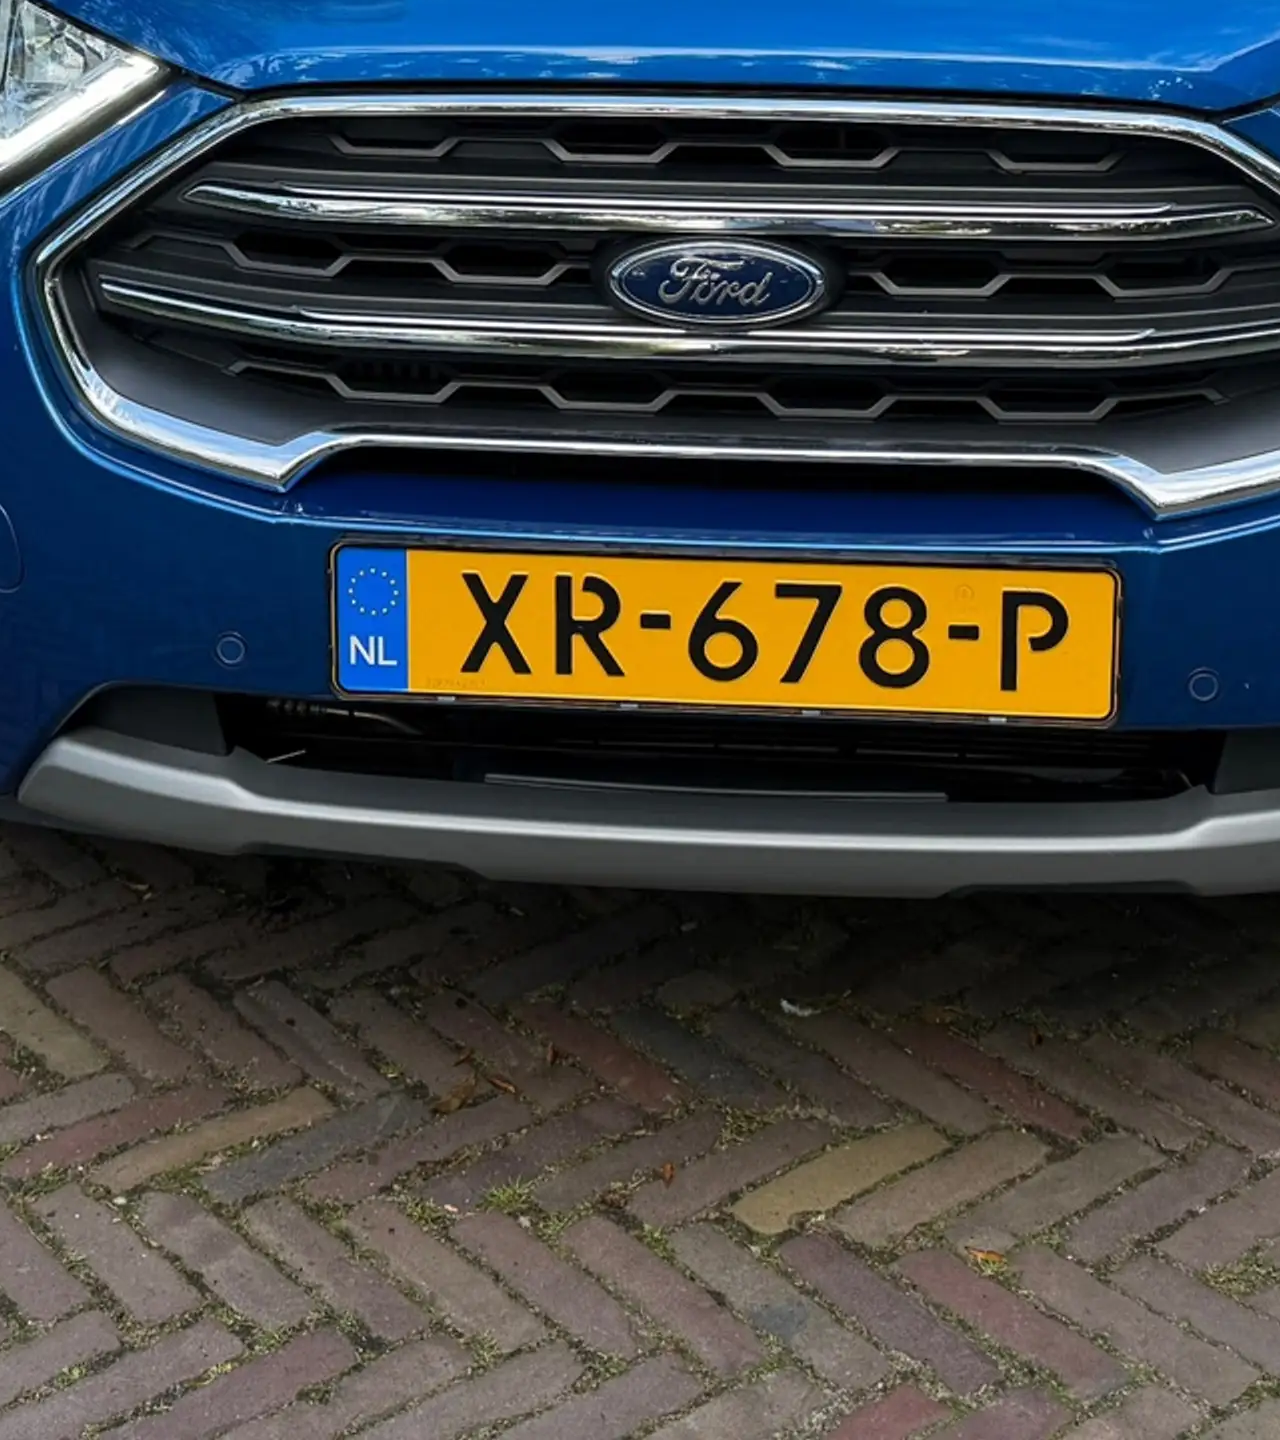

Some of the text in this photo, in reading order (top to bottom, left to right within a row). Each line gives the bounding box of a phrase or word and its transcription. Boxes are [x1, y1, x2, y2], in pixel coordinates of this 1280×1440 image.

[658, 256, 774, 307] Ford
[349, 635, 397, 667] NL
[460, 571, 1069, 692] XR-678-P
